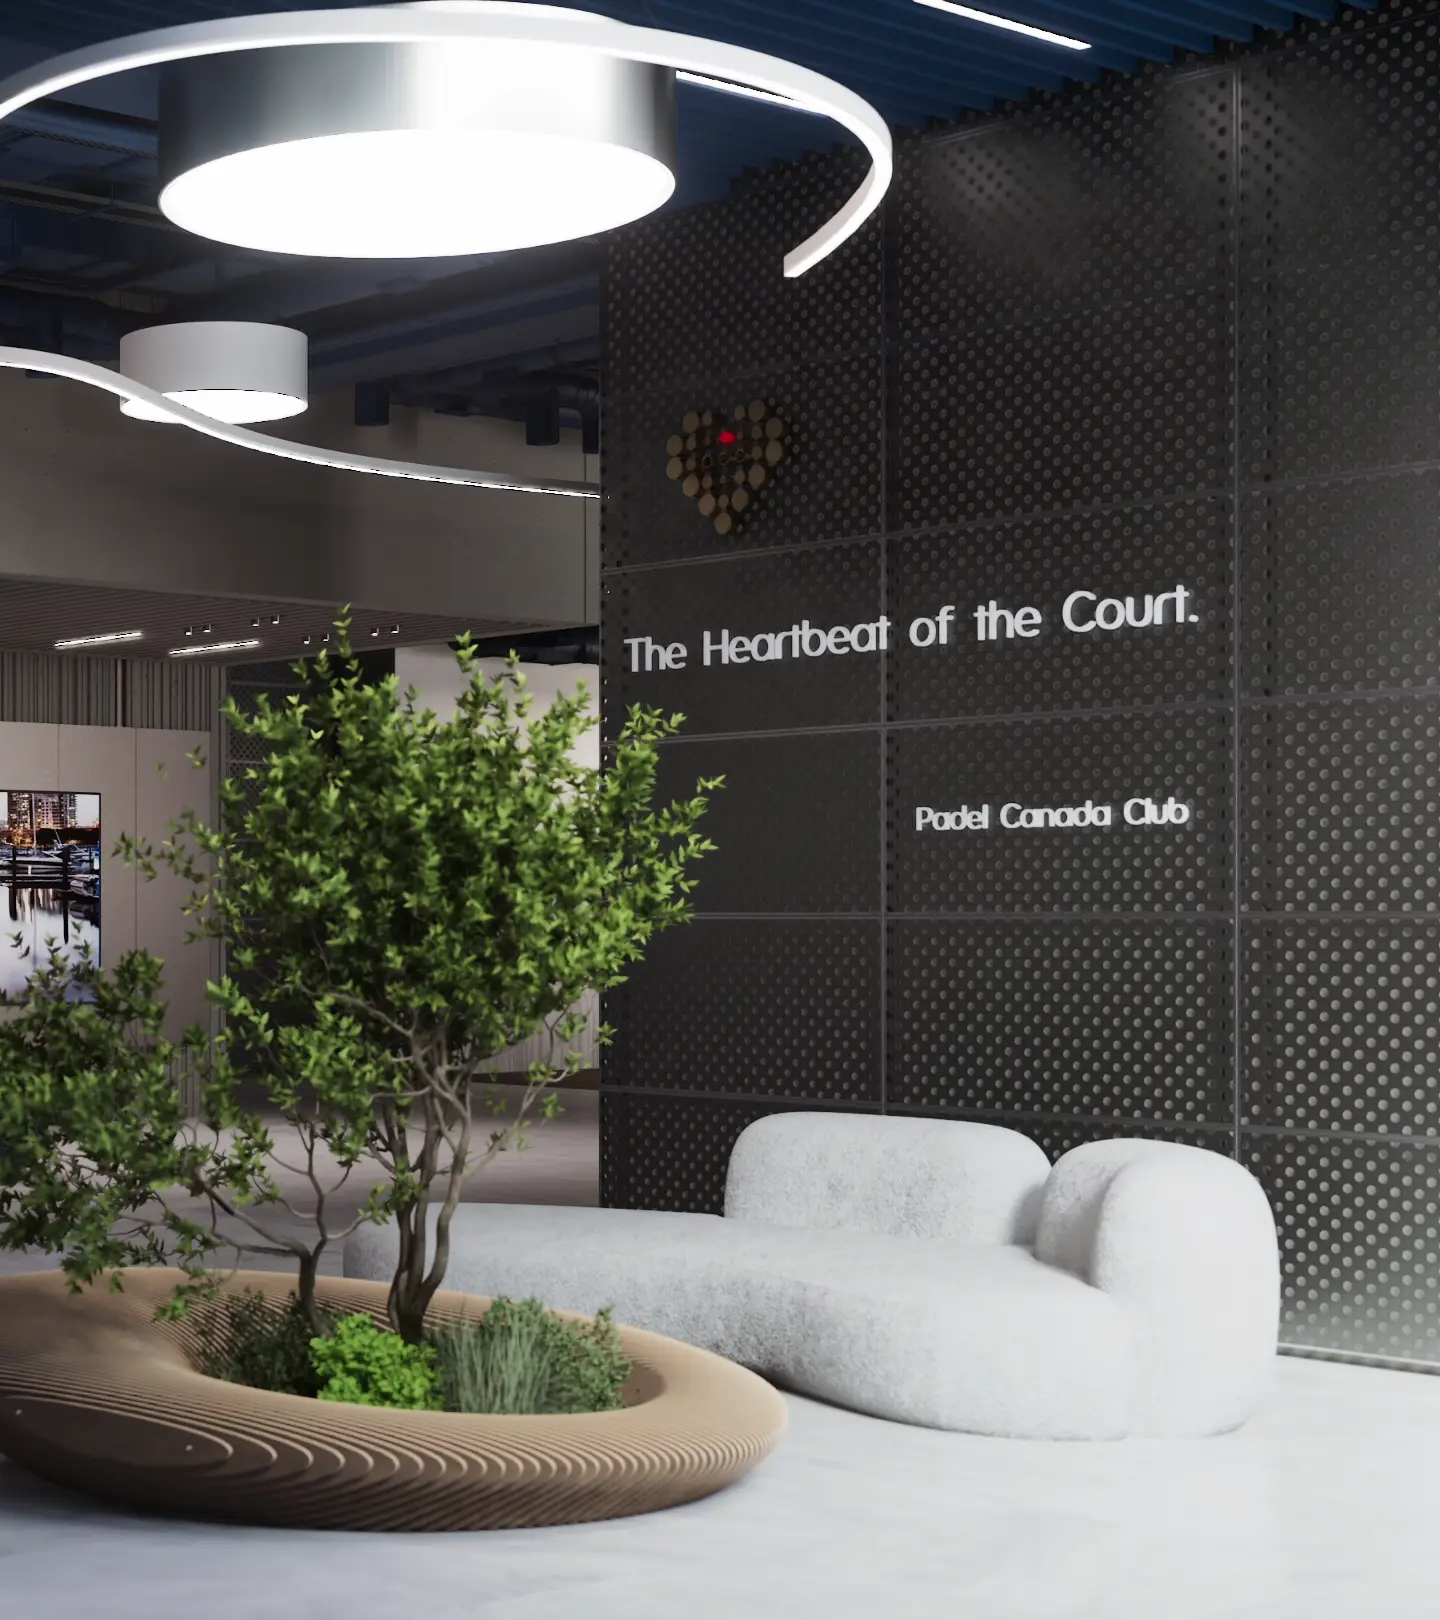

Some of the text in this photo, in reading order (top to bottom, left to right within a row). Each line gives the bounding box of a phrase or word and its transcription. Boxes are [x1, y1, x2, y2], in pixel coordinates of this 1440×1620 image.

[624, 584, 1199, 672] The Heartbeat of the Court.
[915, 796, 1190, 831] Padel Canada Club
